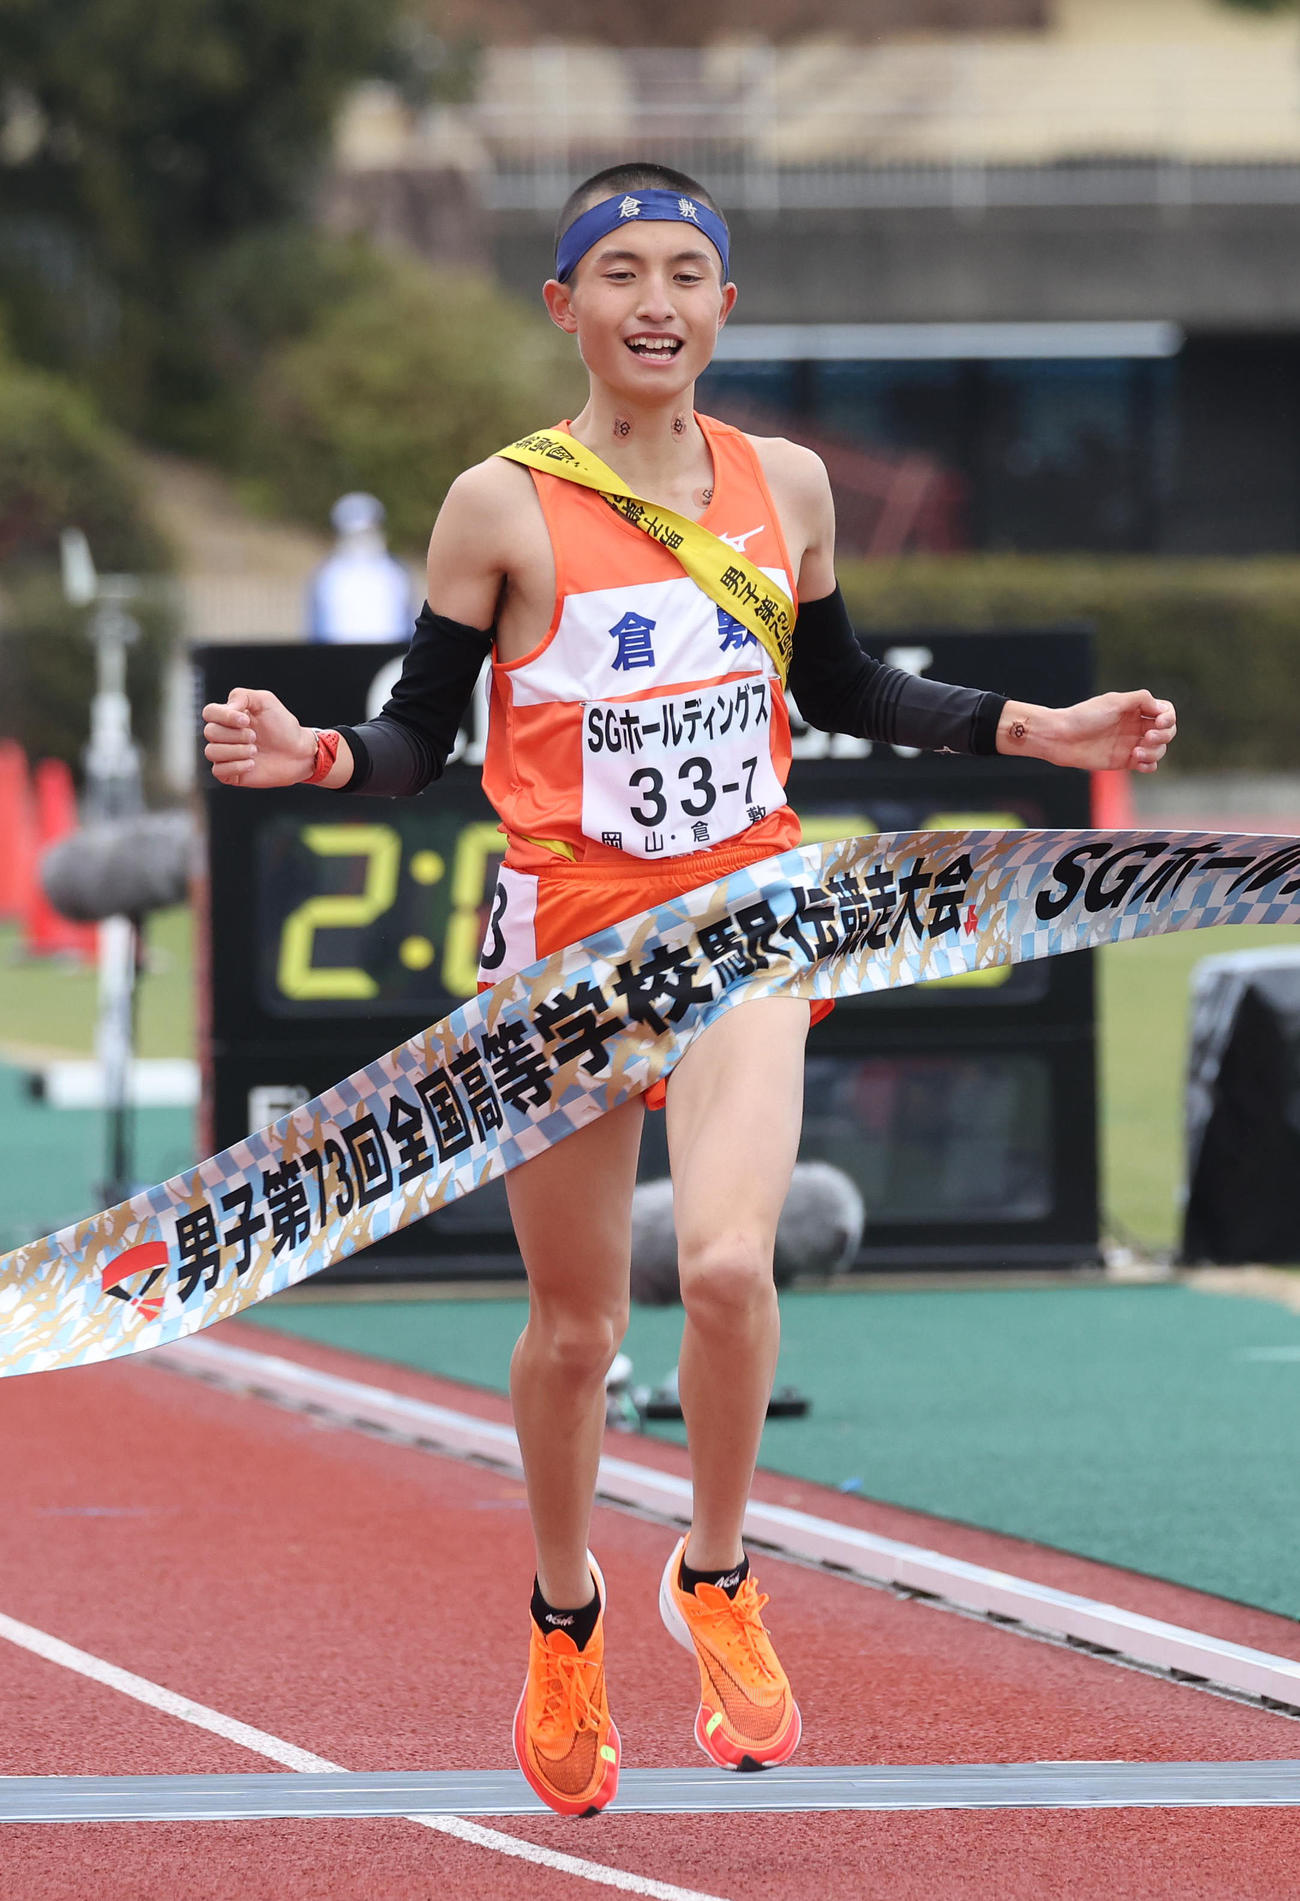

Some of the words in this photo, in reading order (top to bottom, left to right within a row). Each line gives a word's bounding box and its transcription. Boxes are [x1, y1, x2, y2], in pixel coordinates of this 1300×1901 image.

[617, 194, 700, 223] 倉敷
[597, 490, 685, 549] 男子第
[587, 682, 768, 755] SGホールディングス
[628, 755, 759, 828] 33-7
[175, 853, 974, 1302] 男子第73回全国高等学校駅伝競走大会
[1034, 841, 1300, 921] SGホール
